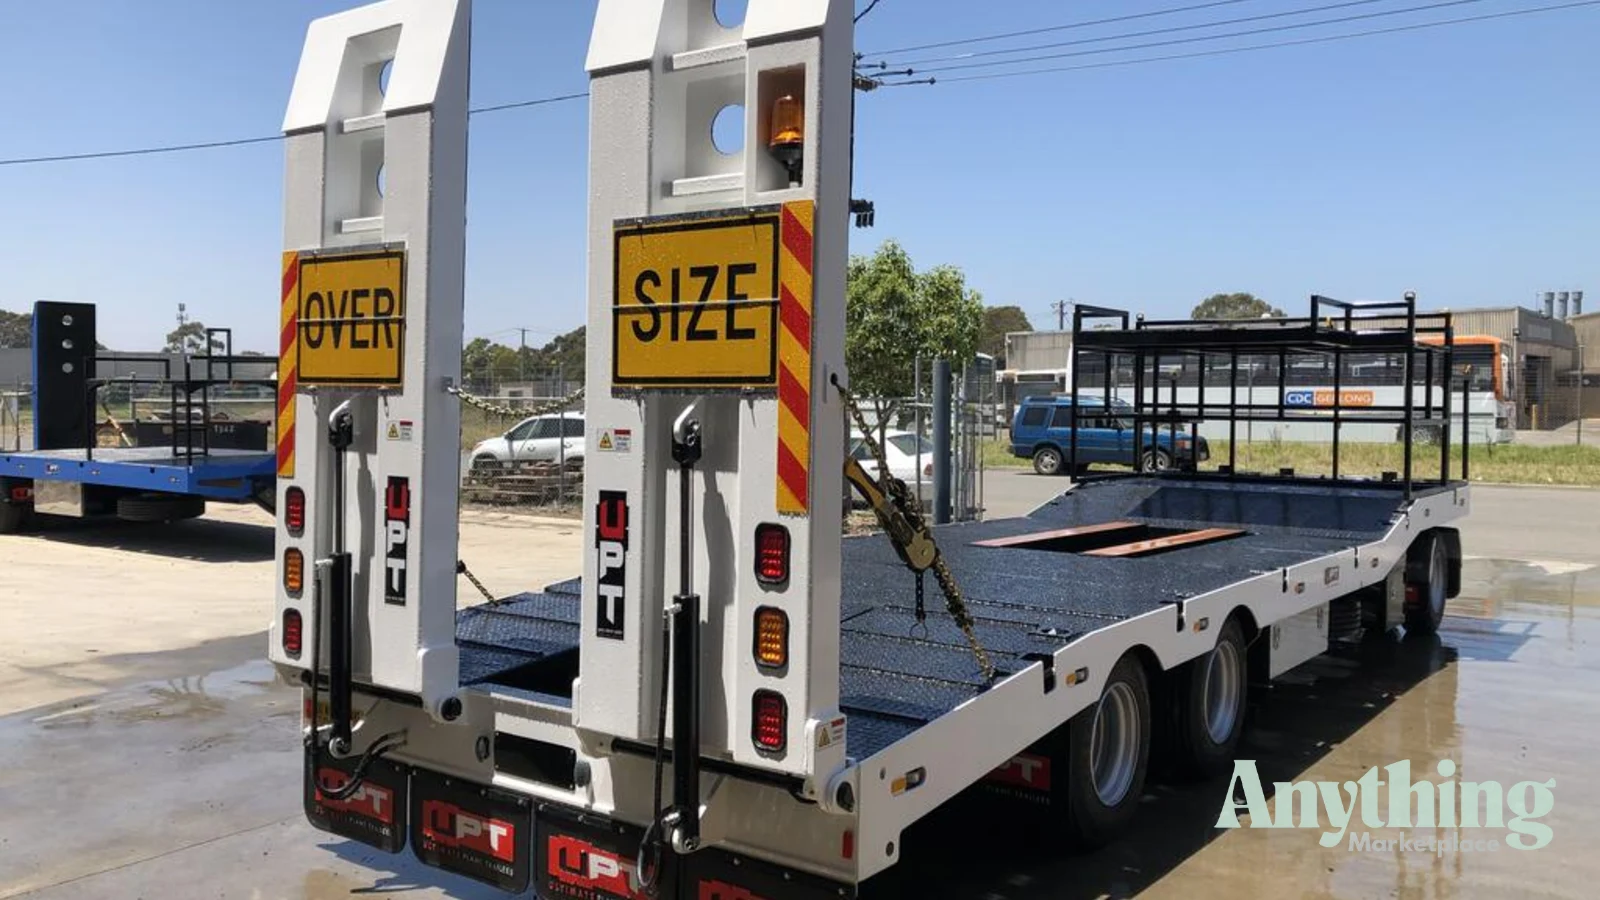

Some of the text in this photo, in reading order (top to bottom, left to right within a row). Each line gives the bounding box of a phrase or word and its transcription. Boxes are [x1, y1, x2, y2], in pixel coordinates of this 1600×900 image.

[305, 287, 395, 350] OVER
[632, 263, 757, 343] SIZE
[1286, 393, 1372, 404] CDC GELONG
[387, 484, 408, 593] UPT
[599, 499, 626, 626] UPT
[430, 808, 508, 853] UPT
[558, 846, 645, 895] UPT
